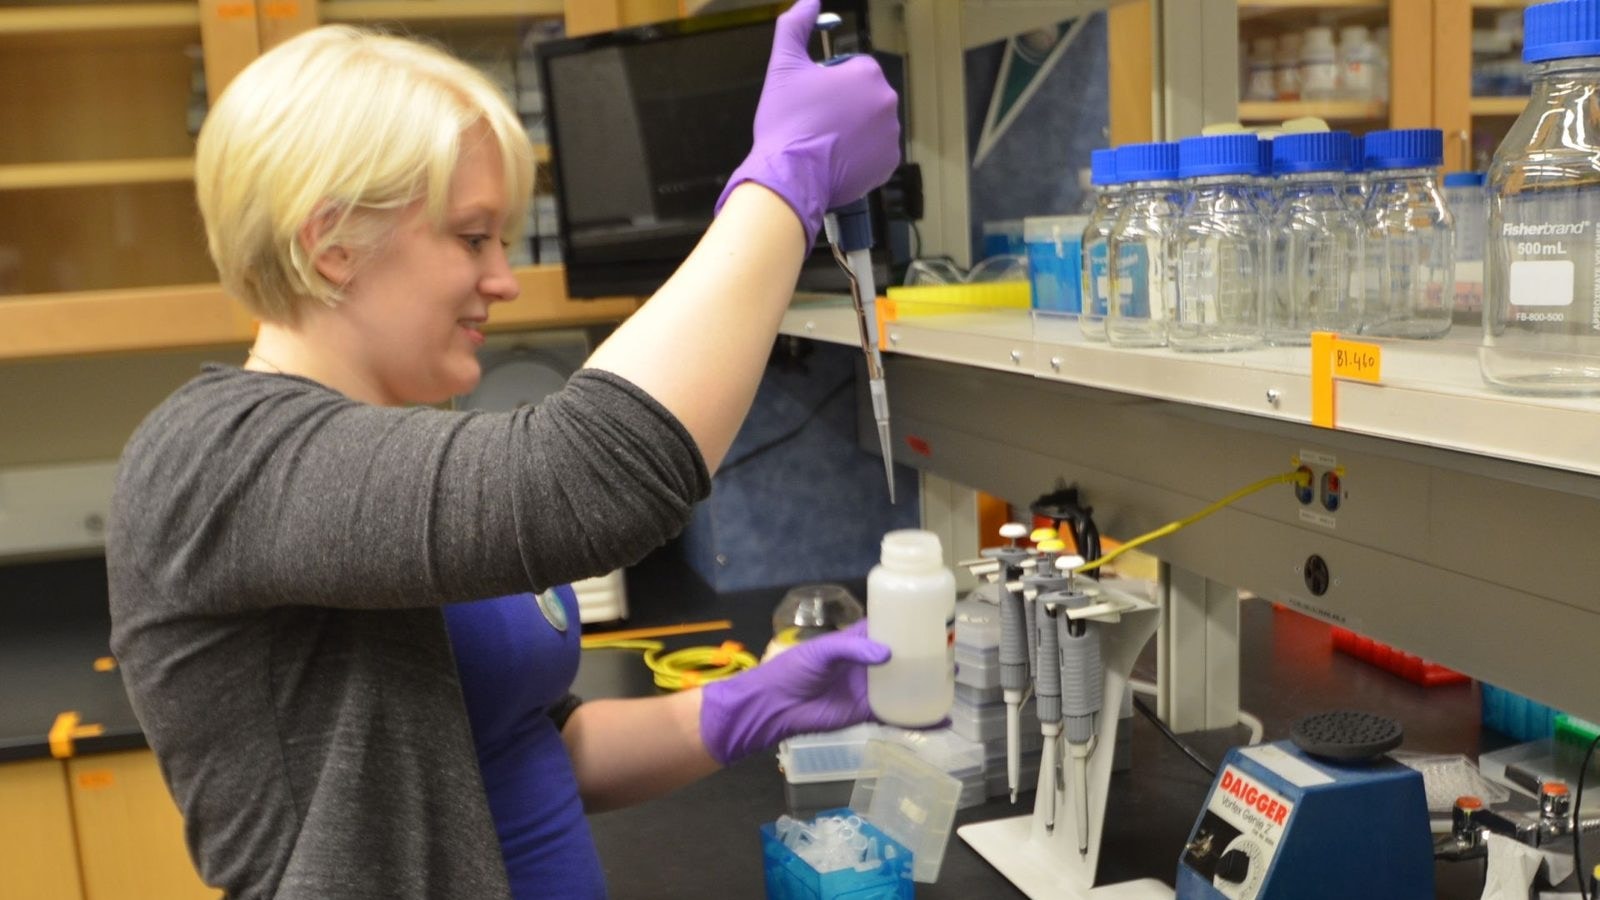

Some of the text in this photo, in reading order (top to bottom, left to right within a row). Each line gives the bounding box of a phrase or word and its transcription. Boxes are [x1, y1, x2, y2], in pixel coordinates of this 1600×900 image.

[1220, 770, 1288, 826] DAIGGER
[1221, 795, 1241, 814] Vortex
[1242, 808, 1264, 831] Genie
